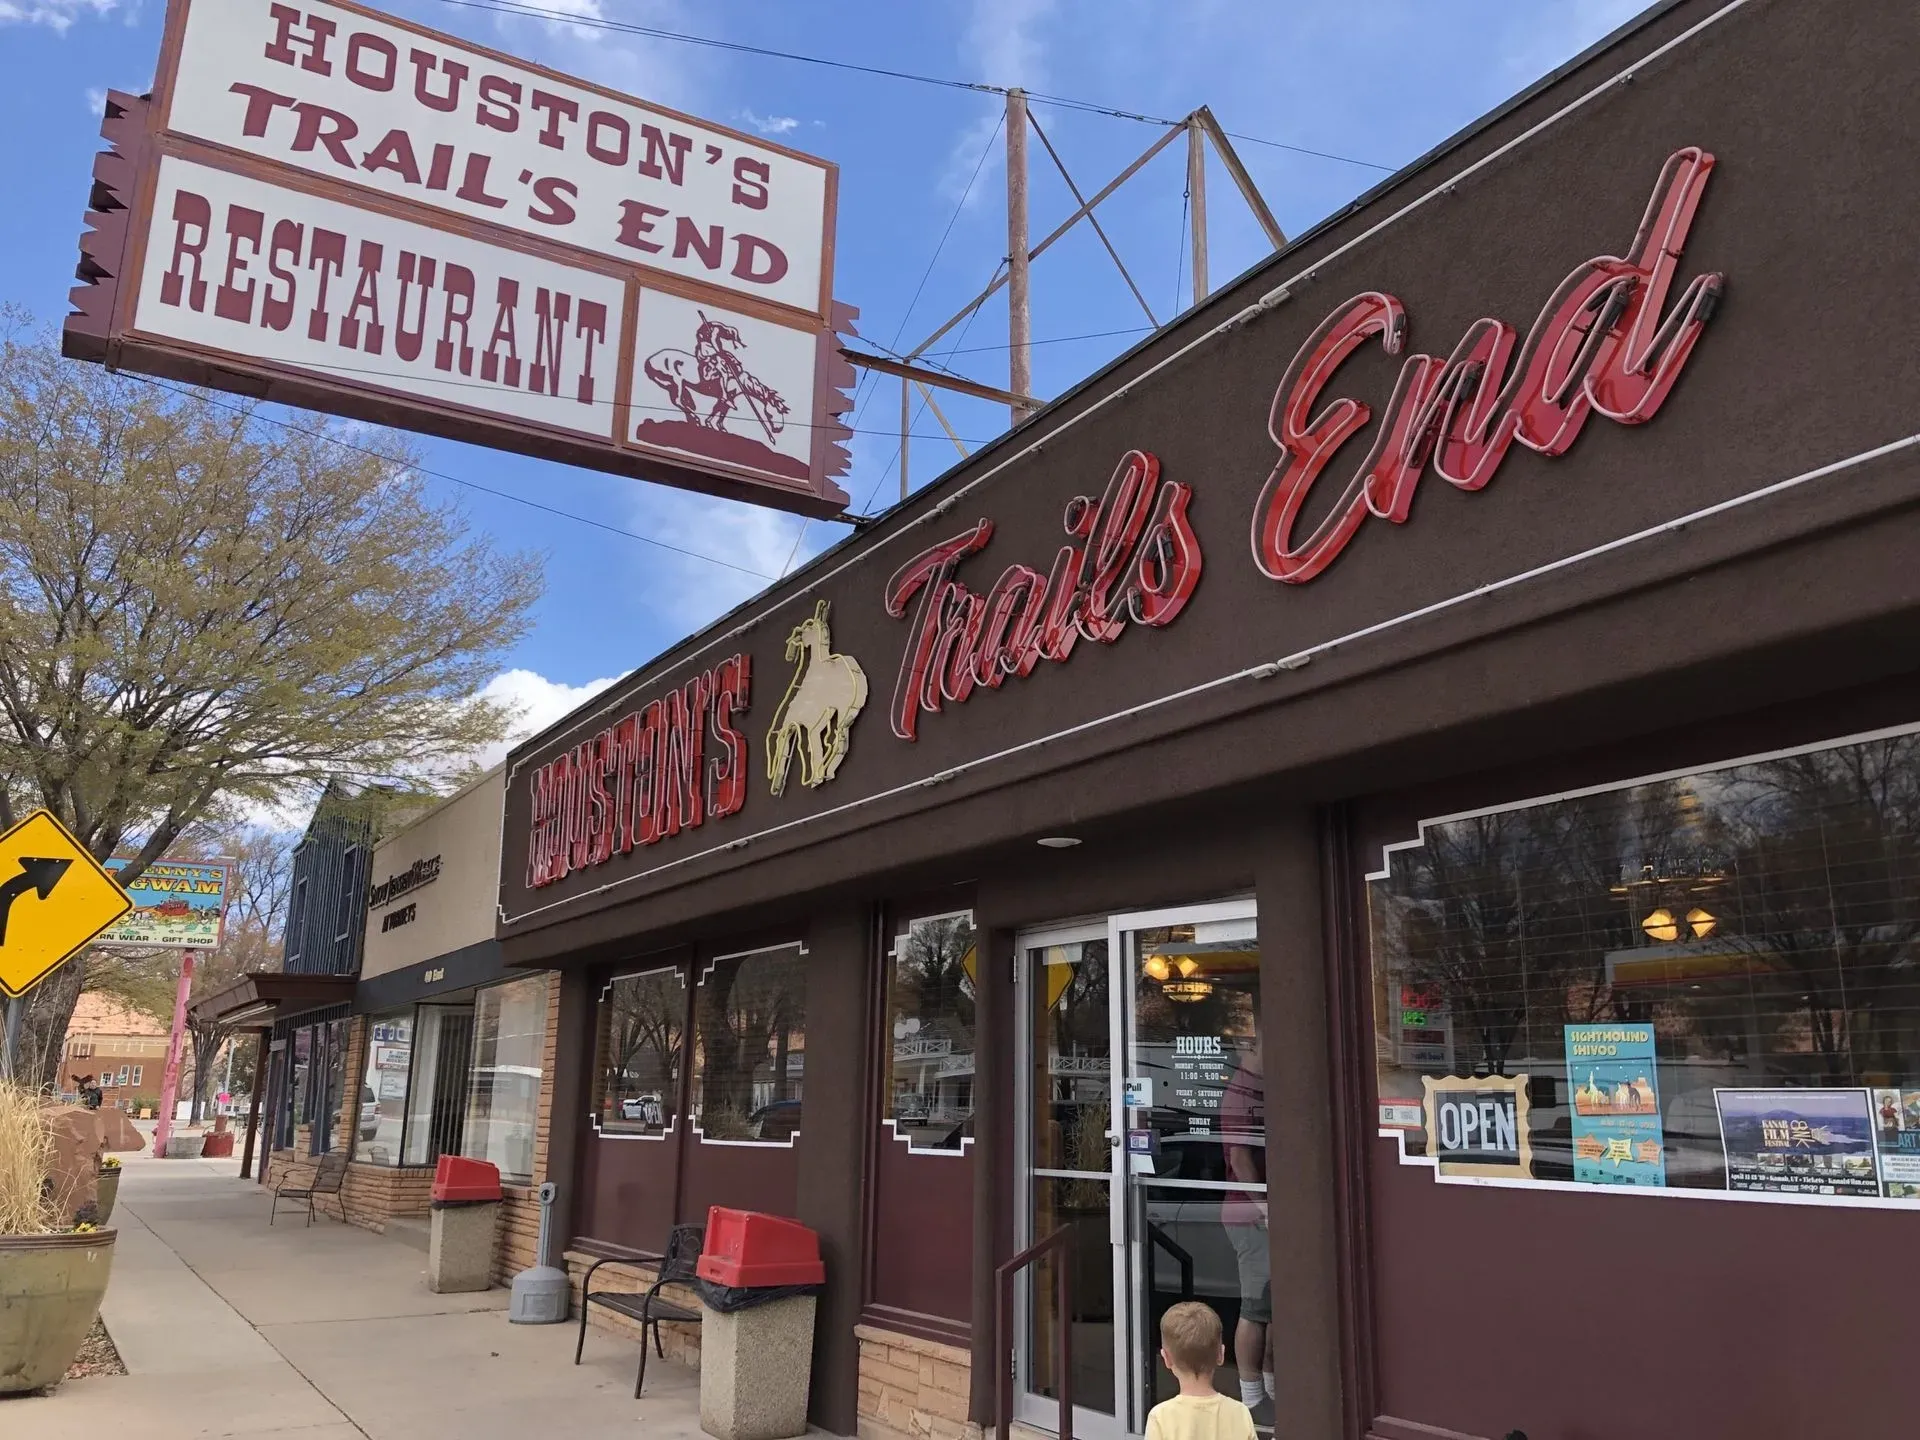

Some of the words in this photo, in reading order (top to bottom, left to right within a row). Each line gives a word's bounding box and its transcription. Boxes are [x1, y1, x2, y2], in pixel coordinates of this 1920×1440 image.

[265, 3, 771, 211] HOUSTON'S
[229, 82, 579, 227] TRAIL'S
[616, 199, 788, 285] END
[160, 189, 607, 405] RESTAURANT
[526, 652, 752, 889] HOUSTON'S
[885, 450, 1202, 741] Trails
[1251, 146, 1727, 584] End
[1571, 1031, 1649, 1042] SIGHTHOUND
[1176, 1036, 1221, 1055] HOURS
[1573, 1045, 1617, 1056] SHIVOO
[1127, 1083, 1141, 1091] Pull
[1189, 1117, 1211, 1125] SUNDAY
[1440, 1102, 1516, 1151] OPEN
[1762, 1119, 1788, 1129] KANAB
[1190, 1127, 1210, 1136] CLOSED
[1763, 1129, 1789, 1140] FILM
[1803, 1176, 1825, 1184] Tickets
